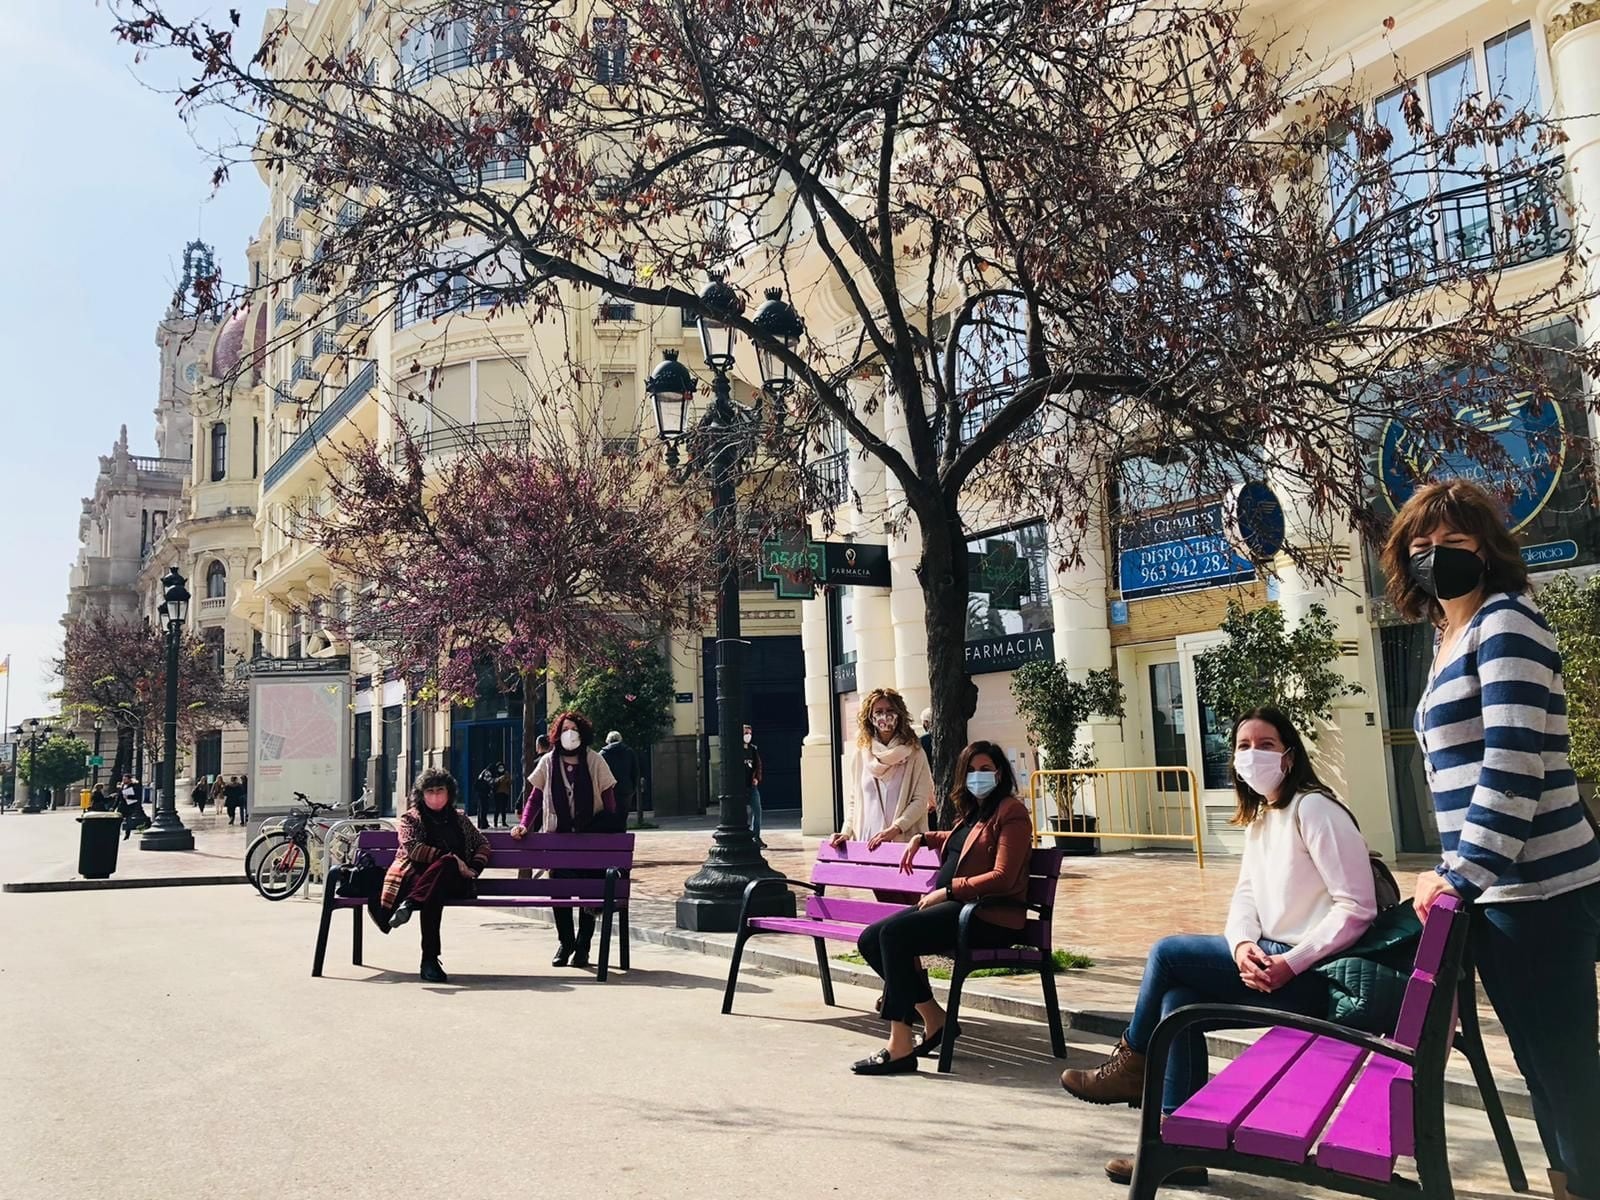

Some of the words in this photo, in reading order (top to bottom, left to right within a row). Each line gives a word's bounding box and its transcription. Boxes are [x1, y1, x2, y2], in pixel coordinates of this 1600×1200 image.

[1141, 540, 1228, 566] DISPONIBLE
[1521, 547, 1563, 561] alencia
[831, 567, 871, 576] FARMACIA
[1141, 564, 1167, 584] 963
[1171, 558, 1199, 579] 942
[1202, 554, 1230, 574] 282
[965, 637, 1044, 661] FARMACIA
